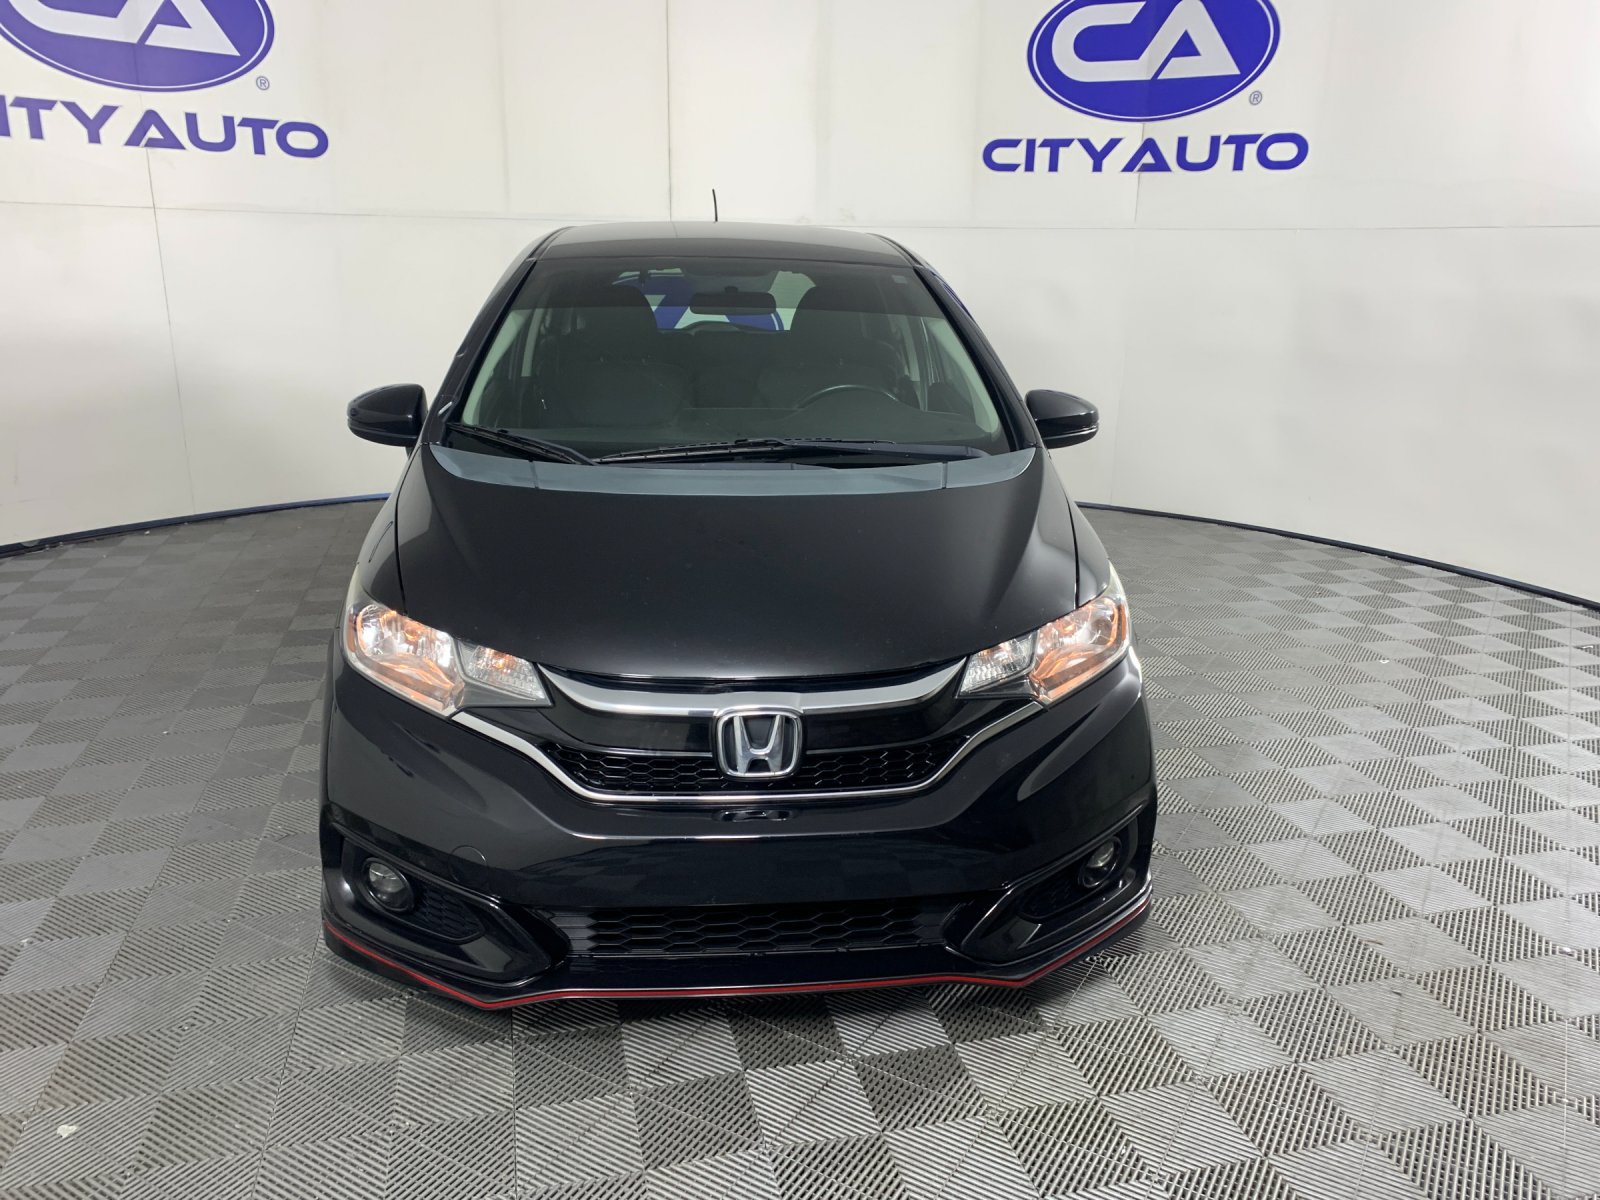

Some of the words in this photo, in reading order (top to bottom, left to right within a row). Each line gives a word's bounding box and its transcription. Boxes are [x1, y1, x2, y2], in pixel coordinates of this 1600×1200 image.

[1051, 0, 1242, 83] CA
[983, 138, 1124, 173] CITY
[1120, 132, 1309, 173] AUTO
